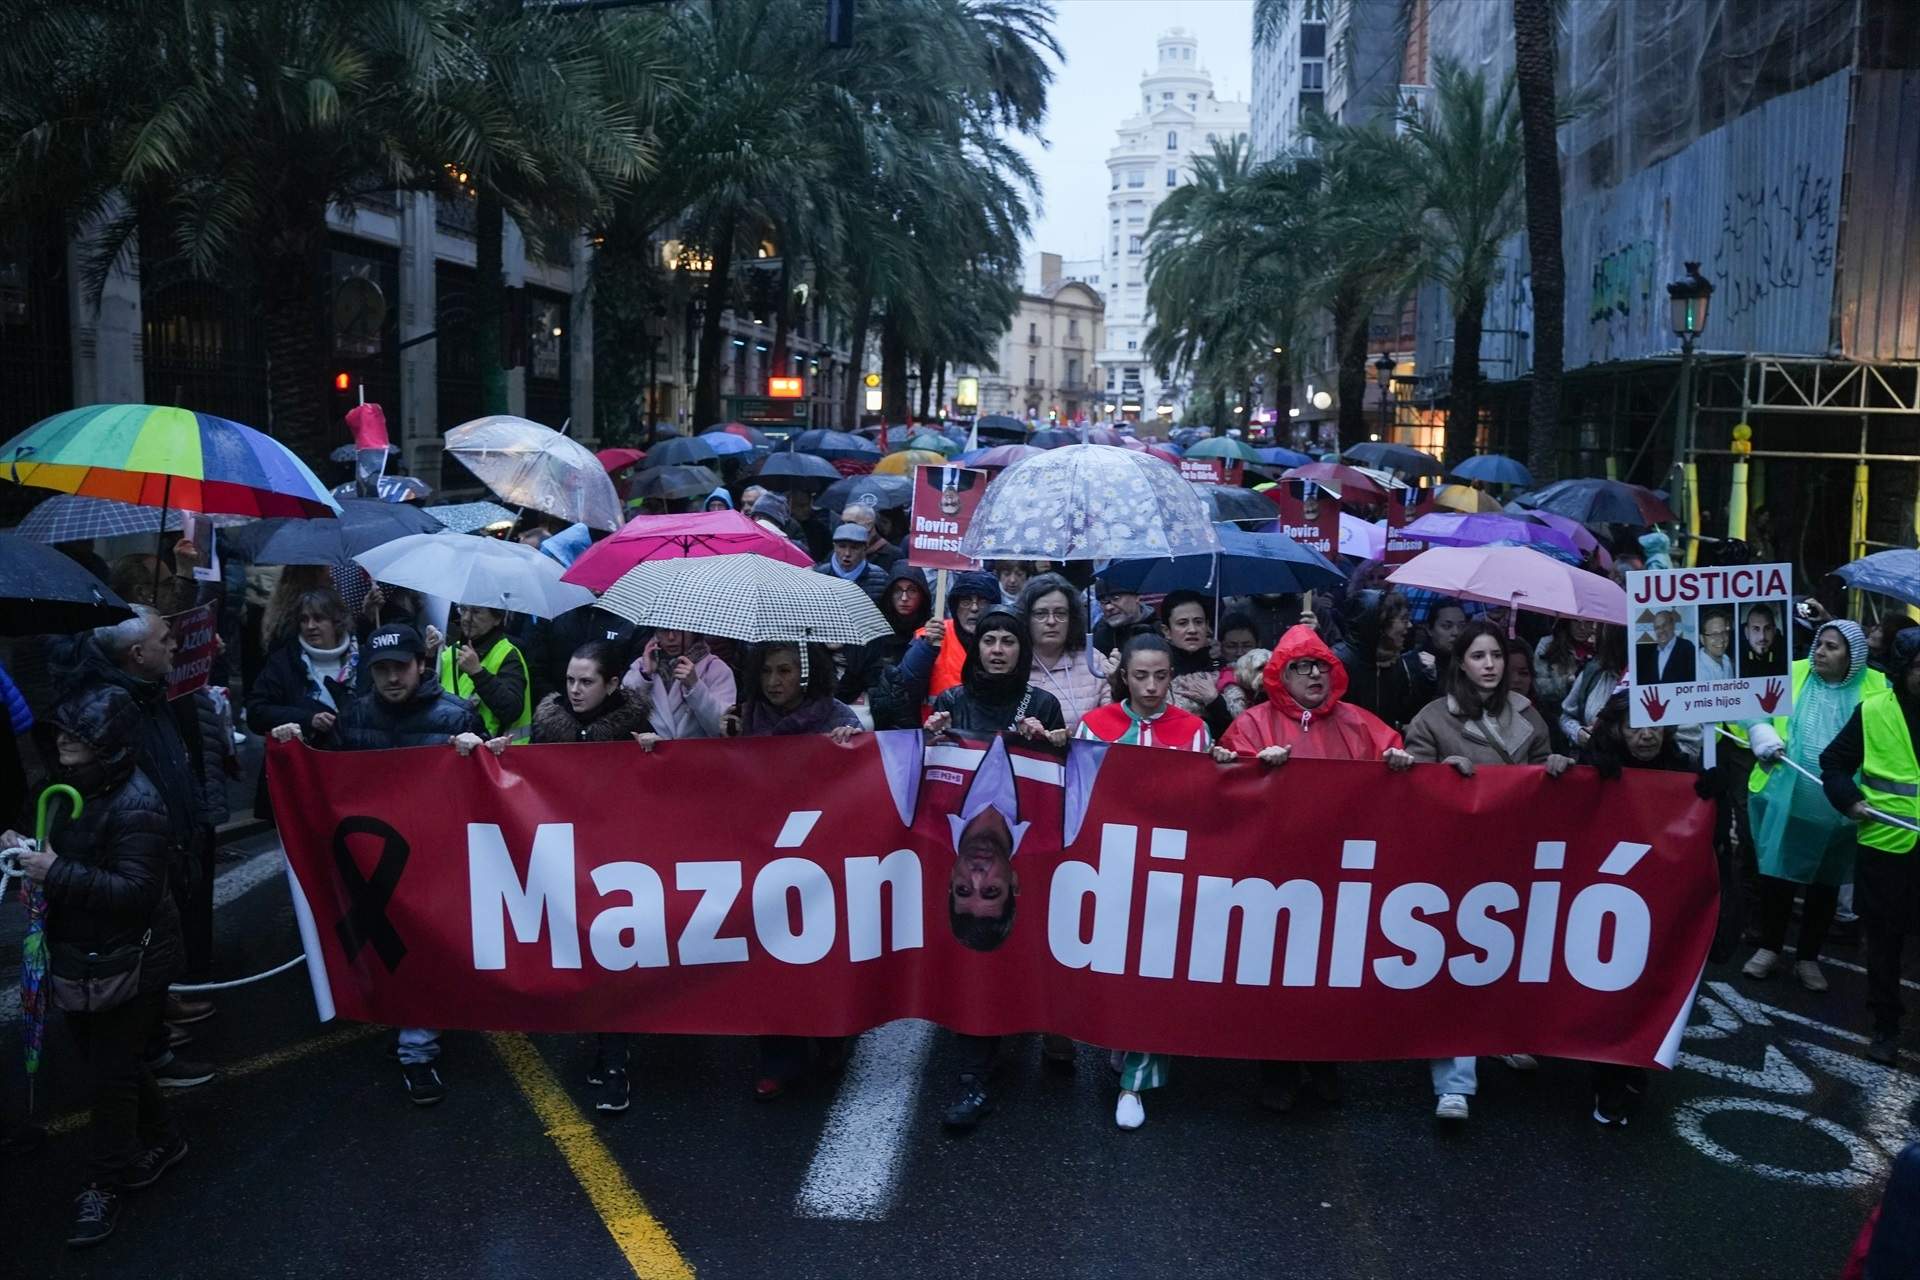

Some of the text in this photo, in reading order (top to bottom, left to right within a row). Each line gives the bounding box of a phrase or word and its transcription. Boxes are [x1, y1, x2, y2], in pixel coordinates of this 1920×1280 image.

[916, 516, 958, 534] Rovira
[1283, 524, 1319, 538] Rovira
[914, 534, 963, 552] dimissi
[1635, 569, 1787, 604] JUSTICIA
[372, 633, 401, 649] SWAT
[1675, 680, 1750, 696] por mi marido
[1014, 693, 1032, 722] adidas
[1685, 696, 1741, 711] y mis hijos
[467, 810, 1652, 992] Mazón dimissió
